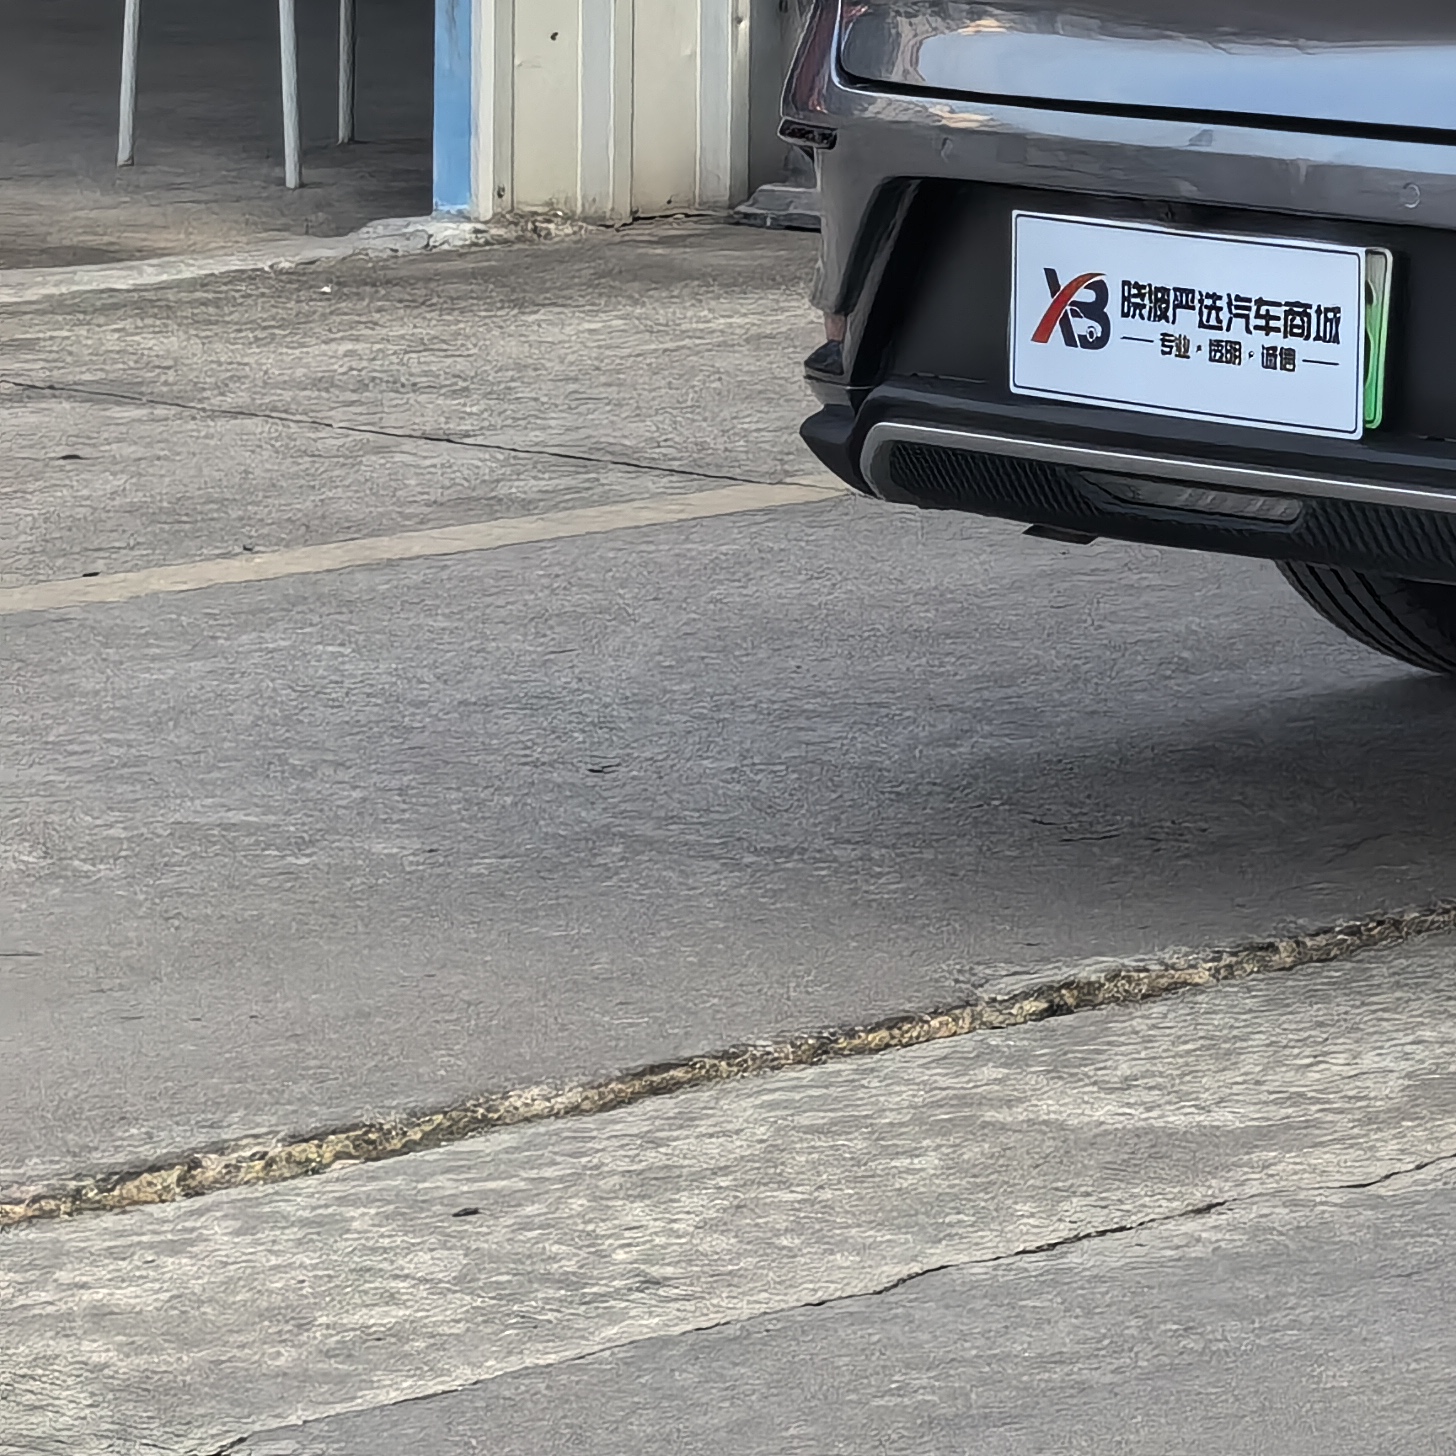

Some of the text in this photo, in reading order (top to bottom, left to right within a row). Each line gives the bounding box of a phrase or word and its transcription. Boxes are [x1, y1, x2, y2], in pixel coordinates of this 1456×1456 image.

[1120, 279, 1342, 346] 晓波严选汽车商城
